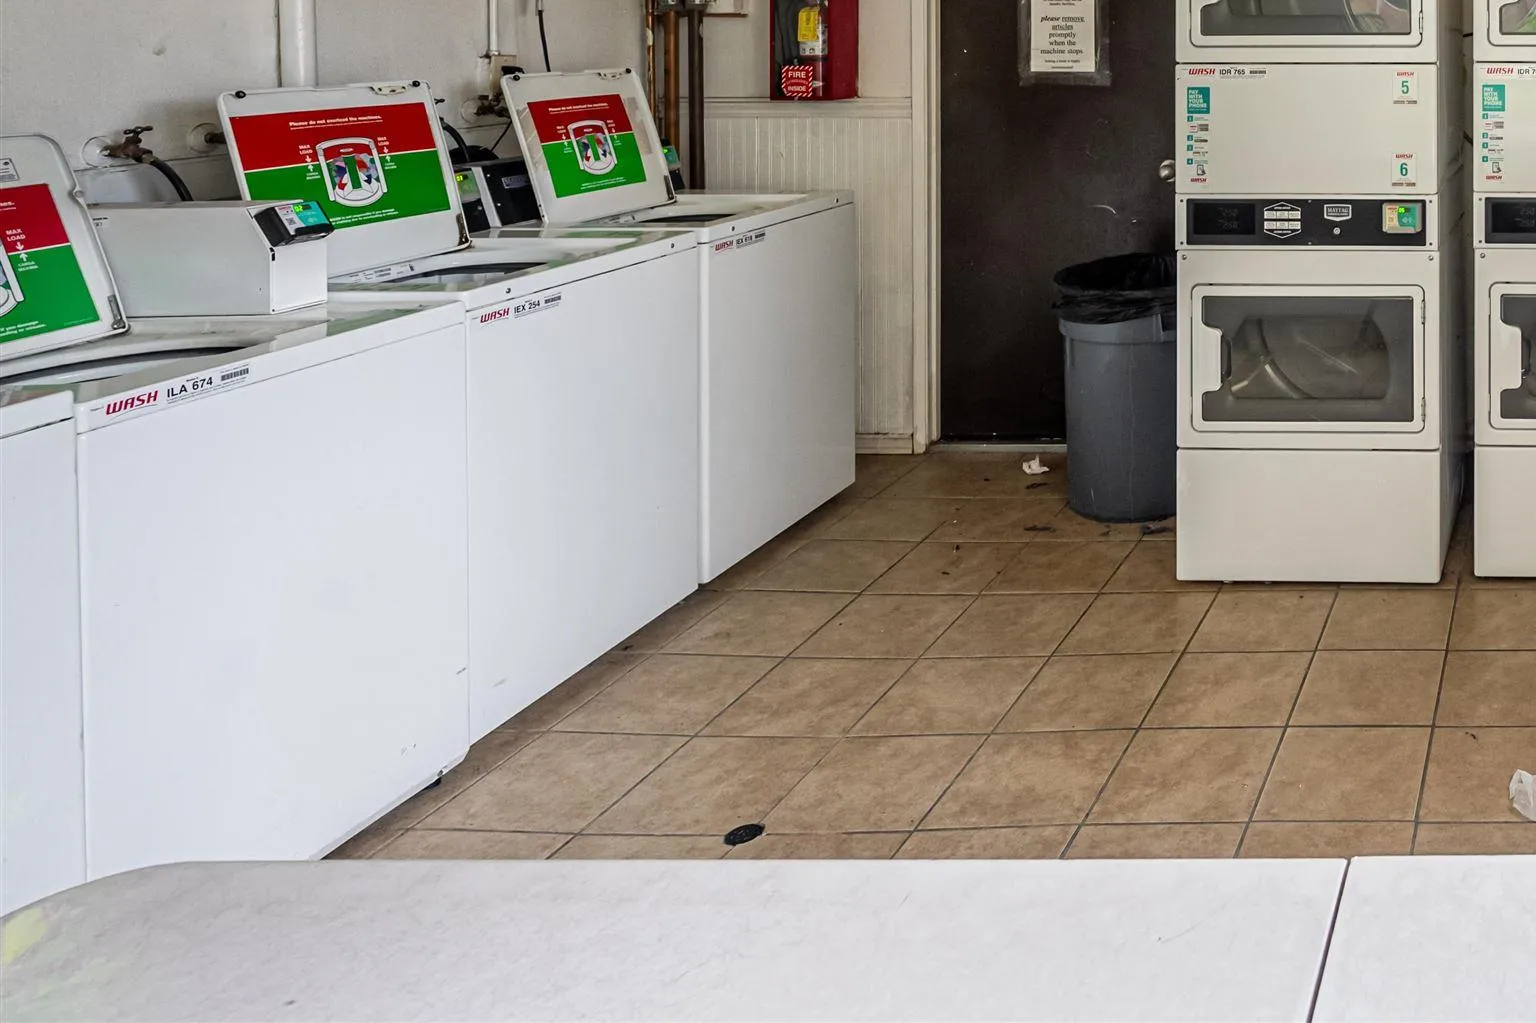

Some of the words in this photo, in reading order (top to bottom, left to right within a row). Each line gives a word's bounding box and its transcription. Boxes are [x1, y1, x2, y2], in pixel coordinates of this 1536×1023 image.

[1040, 15, 1060, 23] please
[1051, 23, 1073, 31] articles
[1048, 31, 1076, 39] promptly
[1401, 80, 1410, 94] 5
[1400, 162, 1408, 176] 6
[7, 234, 26, 242] LOAD
[715, 239, 734, 251] WASH
[480, 307, 510, 323] WASH
[514, 304, 526, 314] IEX
[528, 300, 541, 310] 254
[105, 390, 159, 416] WASH
[166, 384, 188, 398] ILA
[192, 376, 213, 391] 674
